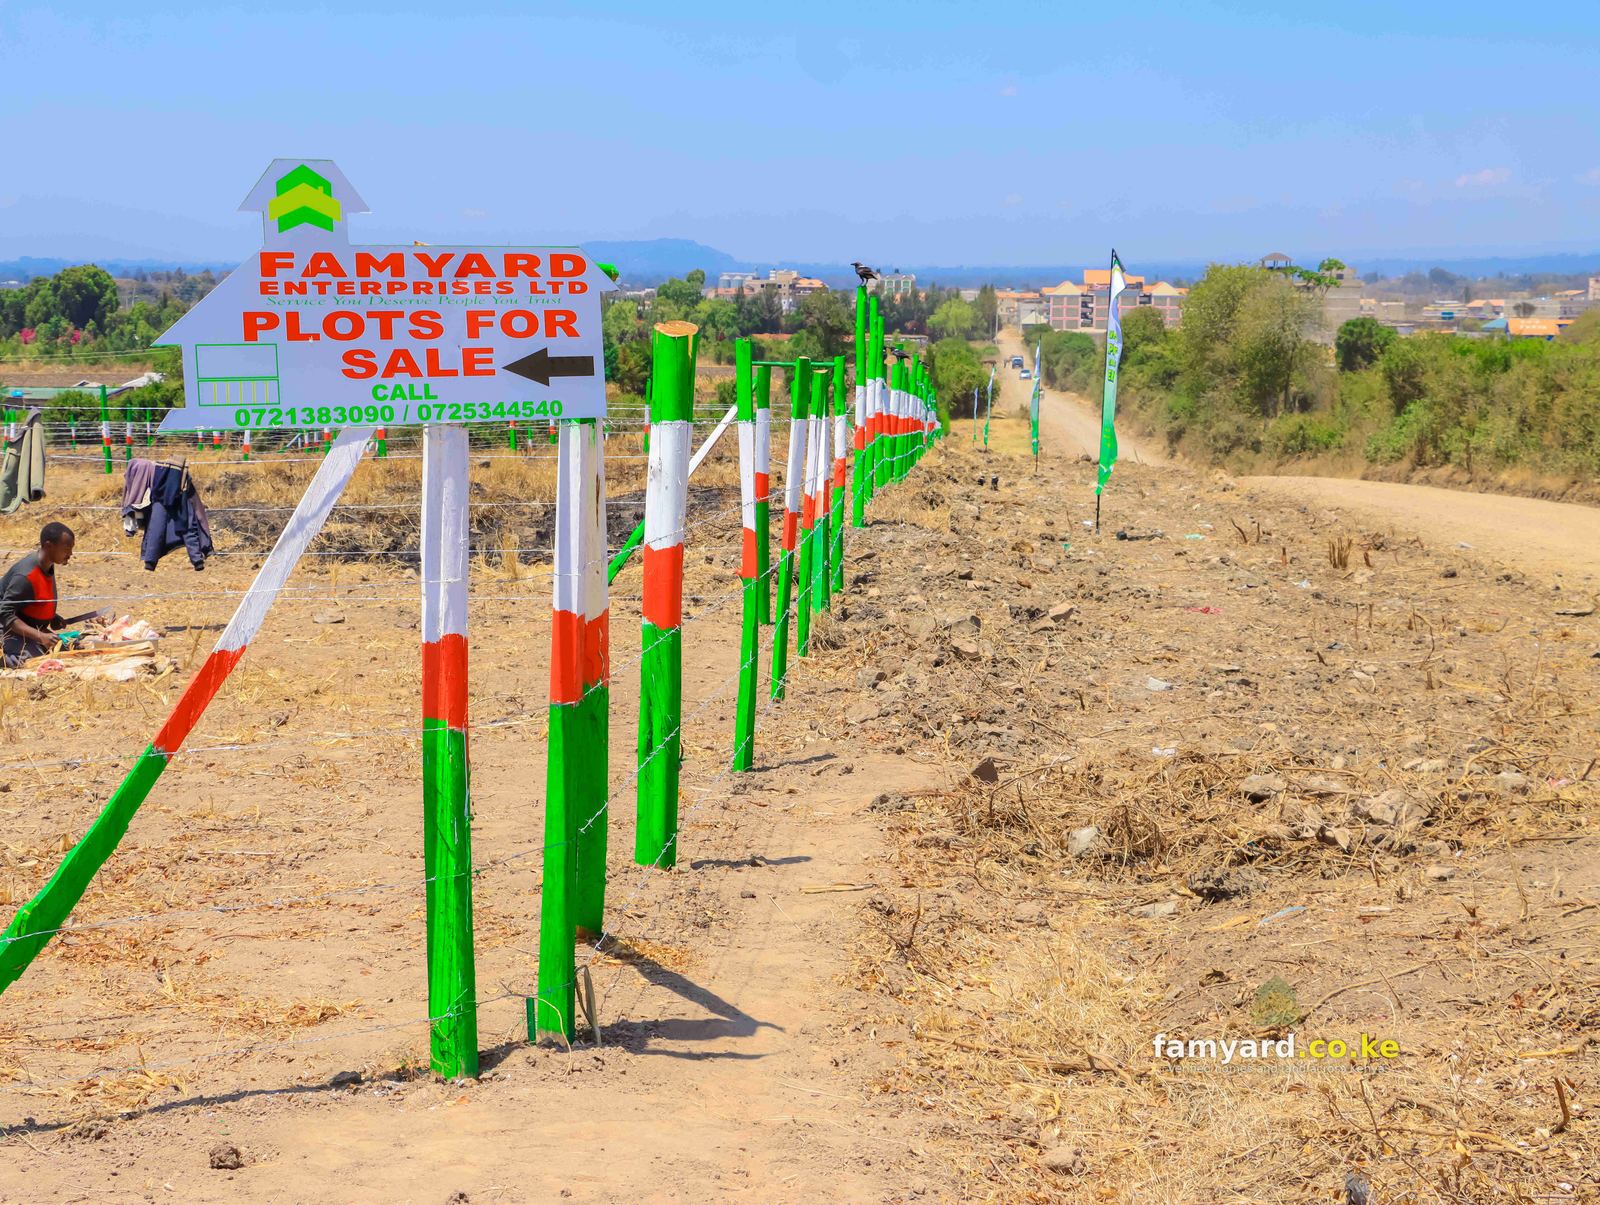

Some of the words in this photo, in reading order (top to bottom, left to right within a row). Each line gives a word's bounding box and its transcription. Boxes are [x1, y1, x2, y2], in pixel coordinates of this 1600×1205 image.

[260, 252, 587, 278] FAMYARD
[259, 280, 514, 295] ENTERPRISES
[530, 280, 589, 295] LTD
[266, 296, 326, 306] Service
[333, 296, 362, 306] You
[368, 296, 432, 306] Deserve
[438, 295, 487, 307] People
[492, 296, 520, 305] You
[528, 295, 562, 305] Trust
[243, 310, 444, 342] PLOTS
[466, 309, 580, 339] FOR
[341, 347, 496, 379] SALE
[371, 383, 439, 402] CALL
[234, 405, 395, 427] 0721383090
[417, 400, 564, 422] 0725344540
